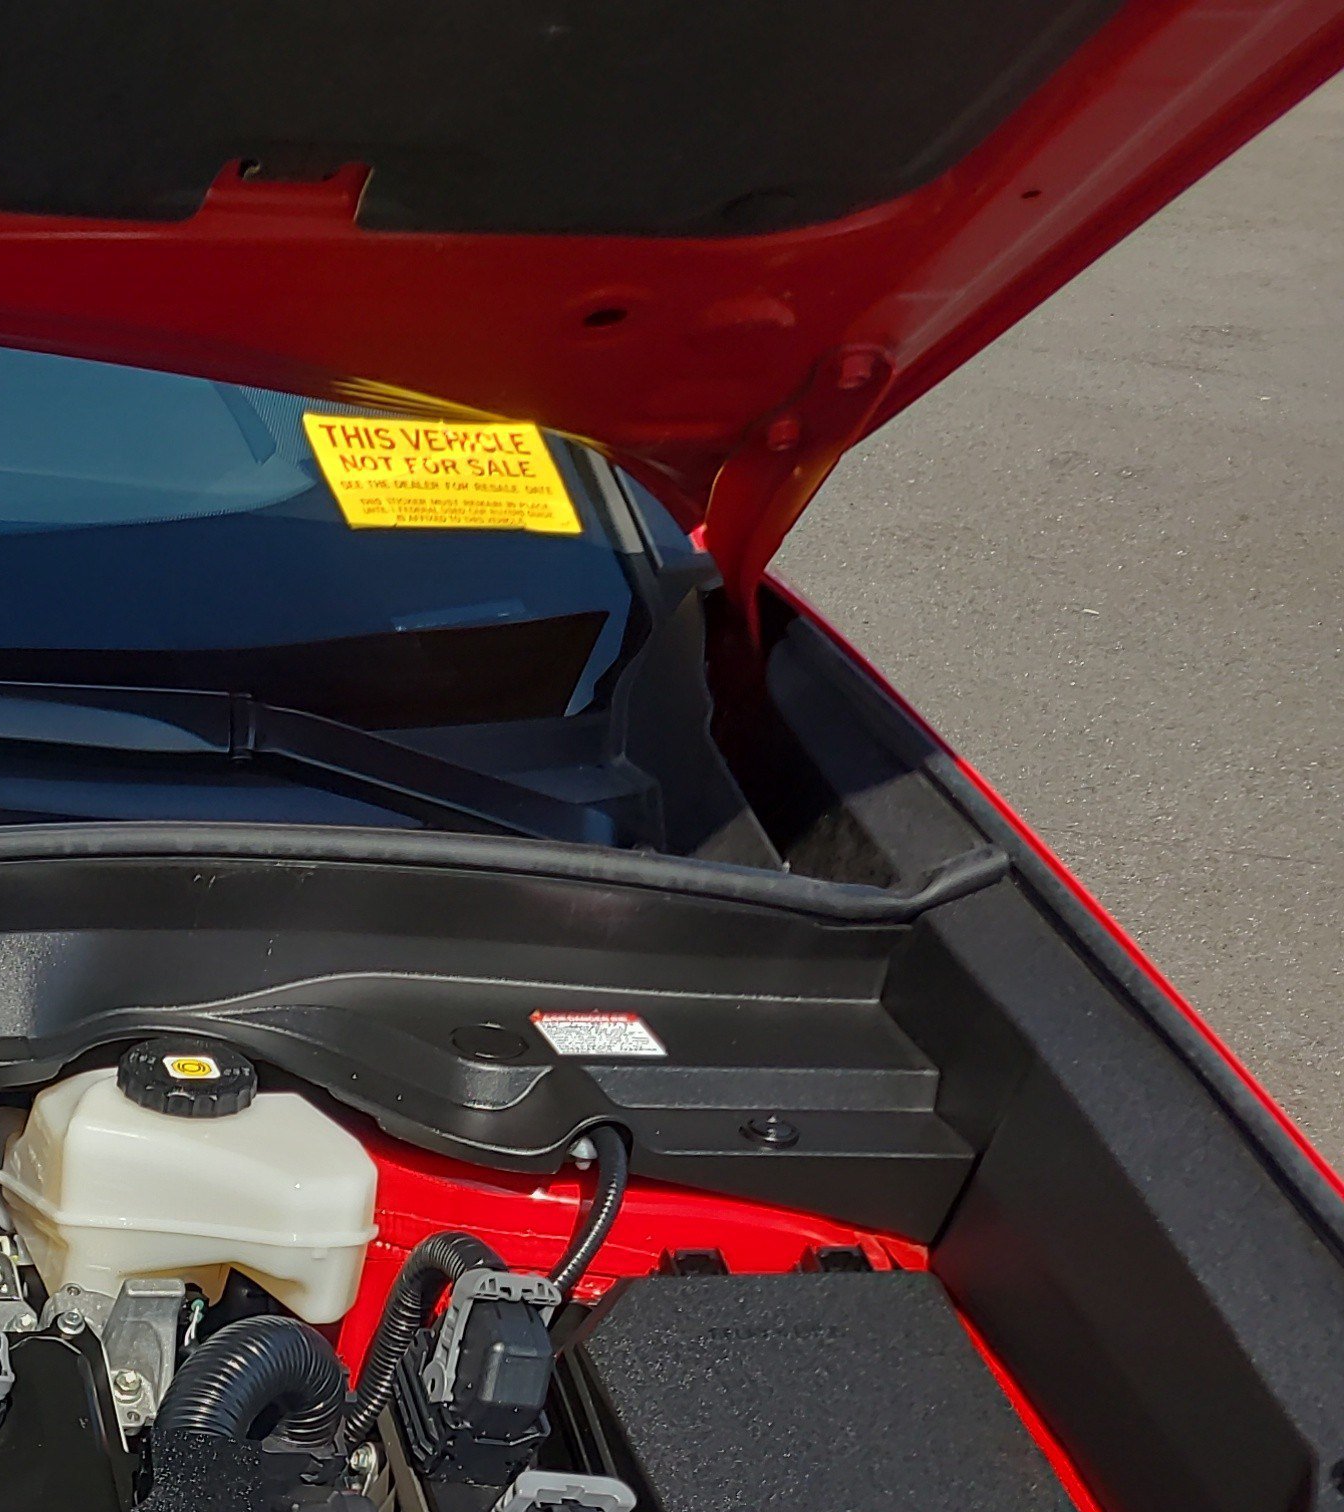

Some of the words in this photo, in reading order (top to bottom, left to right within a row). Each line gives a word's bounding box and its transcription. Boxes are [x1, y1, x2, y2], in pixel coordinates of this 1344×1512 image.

[318, 424, 396, 450] THIS
[400, 428, 532, 455] VEHICLE
[339, 454, 393, 473] NOT
[404, 457, 462, 475] FOR
[467, 459, 537, 478] SALE
[394, 480, 439, 490] DEALER
